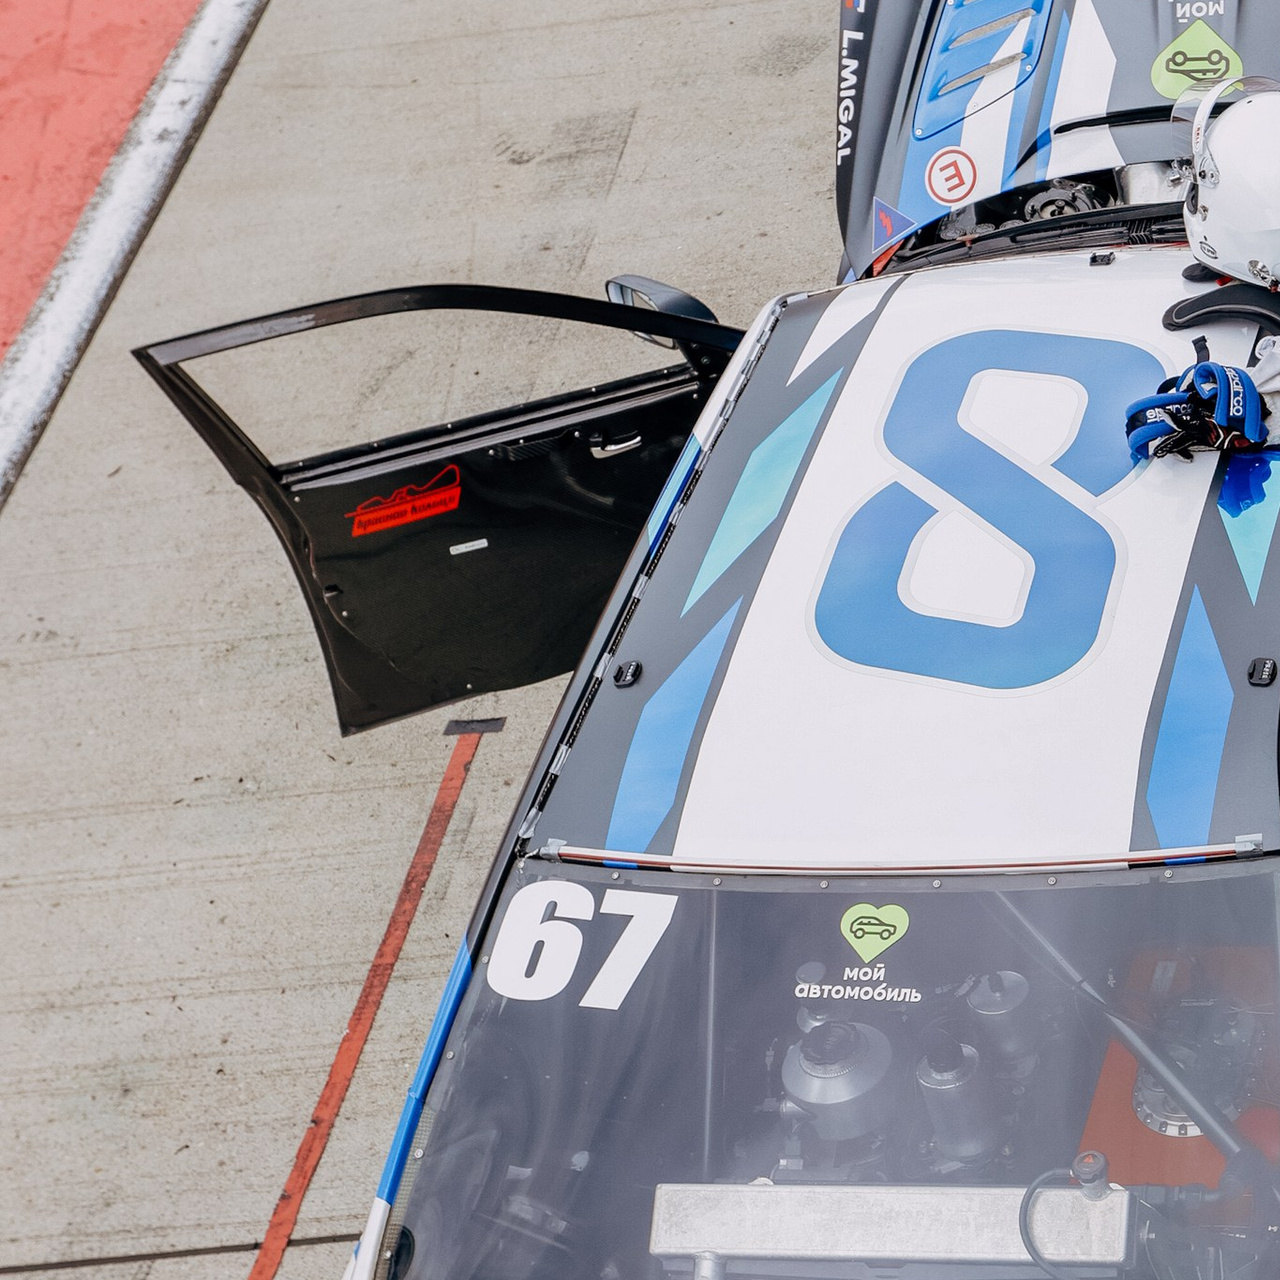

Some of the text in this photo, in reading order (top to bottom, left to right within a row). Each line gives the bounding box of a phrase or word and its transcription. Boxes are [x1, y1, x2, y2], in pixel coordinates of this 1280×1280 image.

[837, 29, 864, 166] L.MIGAL
[1225, 366, 1244, 417] sparco
[814, 329, 1169, 689] 8
[485, 879, 679, 1011] 67
